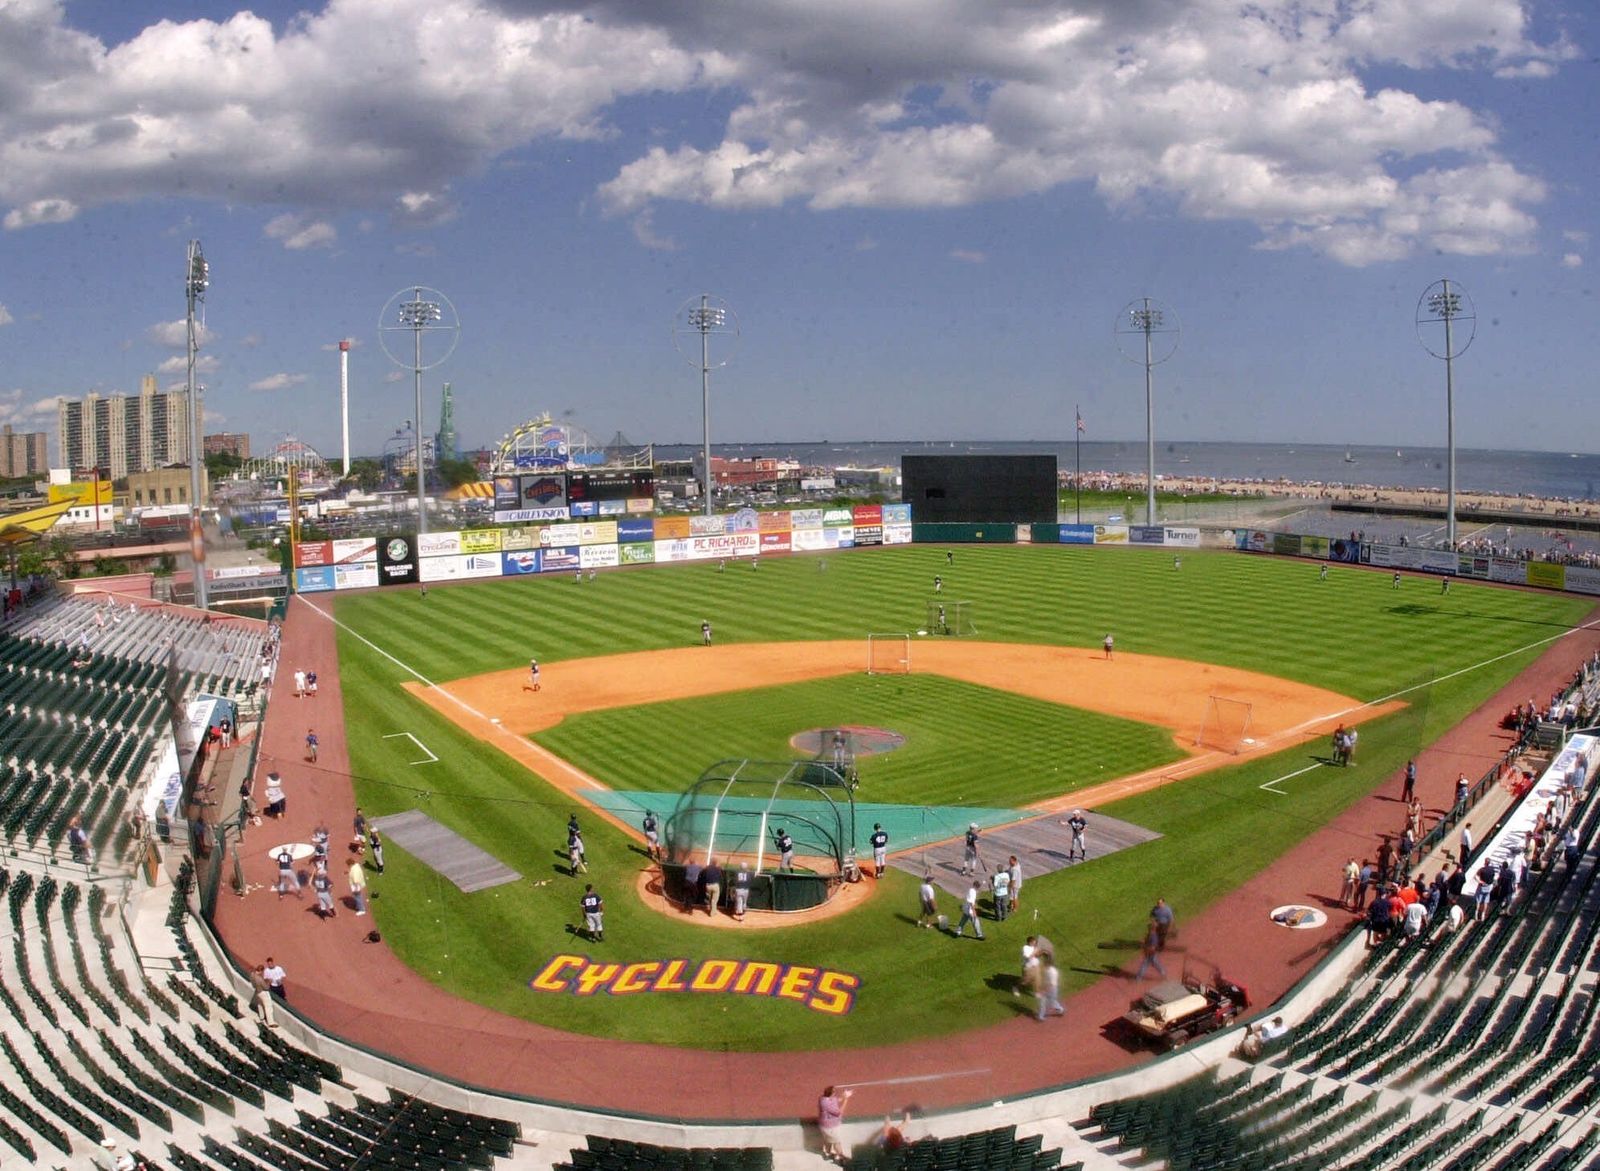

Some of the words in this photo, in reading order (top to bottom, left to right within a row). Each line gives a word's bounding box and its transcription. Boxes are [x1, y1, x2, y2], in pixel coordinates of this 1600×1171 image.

[508, 510, 565, 521] CABLEVISION
[1166, 530, 1198, 541] Turner
[694, 539, 707, 550] PC
[708, 536, 749, 549] RICHARD
[529, 953, 862, 1016] CYCLONES
